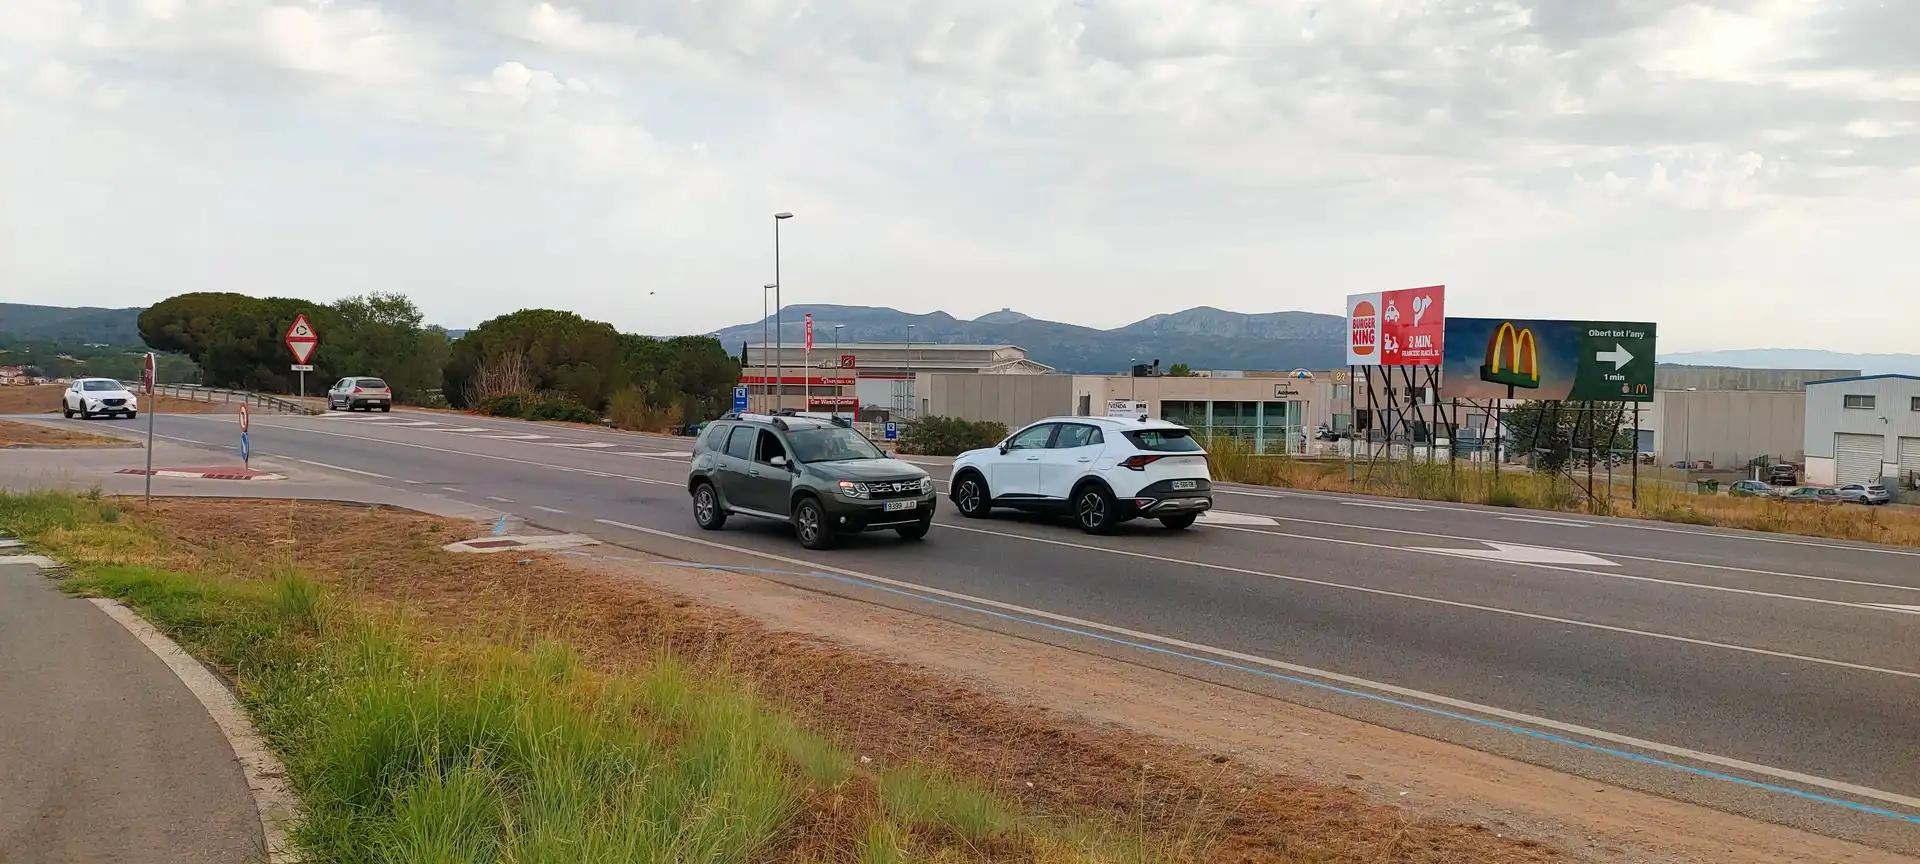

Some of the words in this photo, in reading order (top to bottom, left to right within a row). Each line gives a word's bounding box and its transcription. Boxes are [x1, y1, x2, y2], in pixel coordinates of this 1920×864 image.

[1353, 317, 1375, 329] BURGER
[1353, 329, 1375, 345] KING
[1626, 330, 1644, 340] l'any
[1408, 336, 1414, 348] 2
[1414, 335, 1432, 348] MIN.
